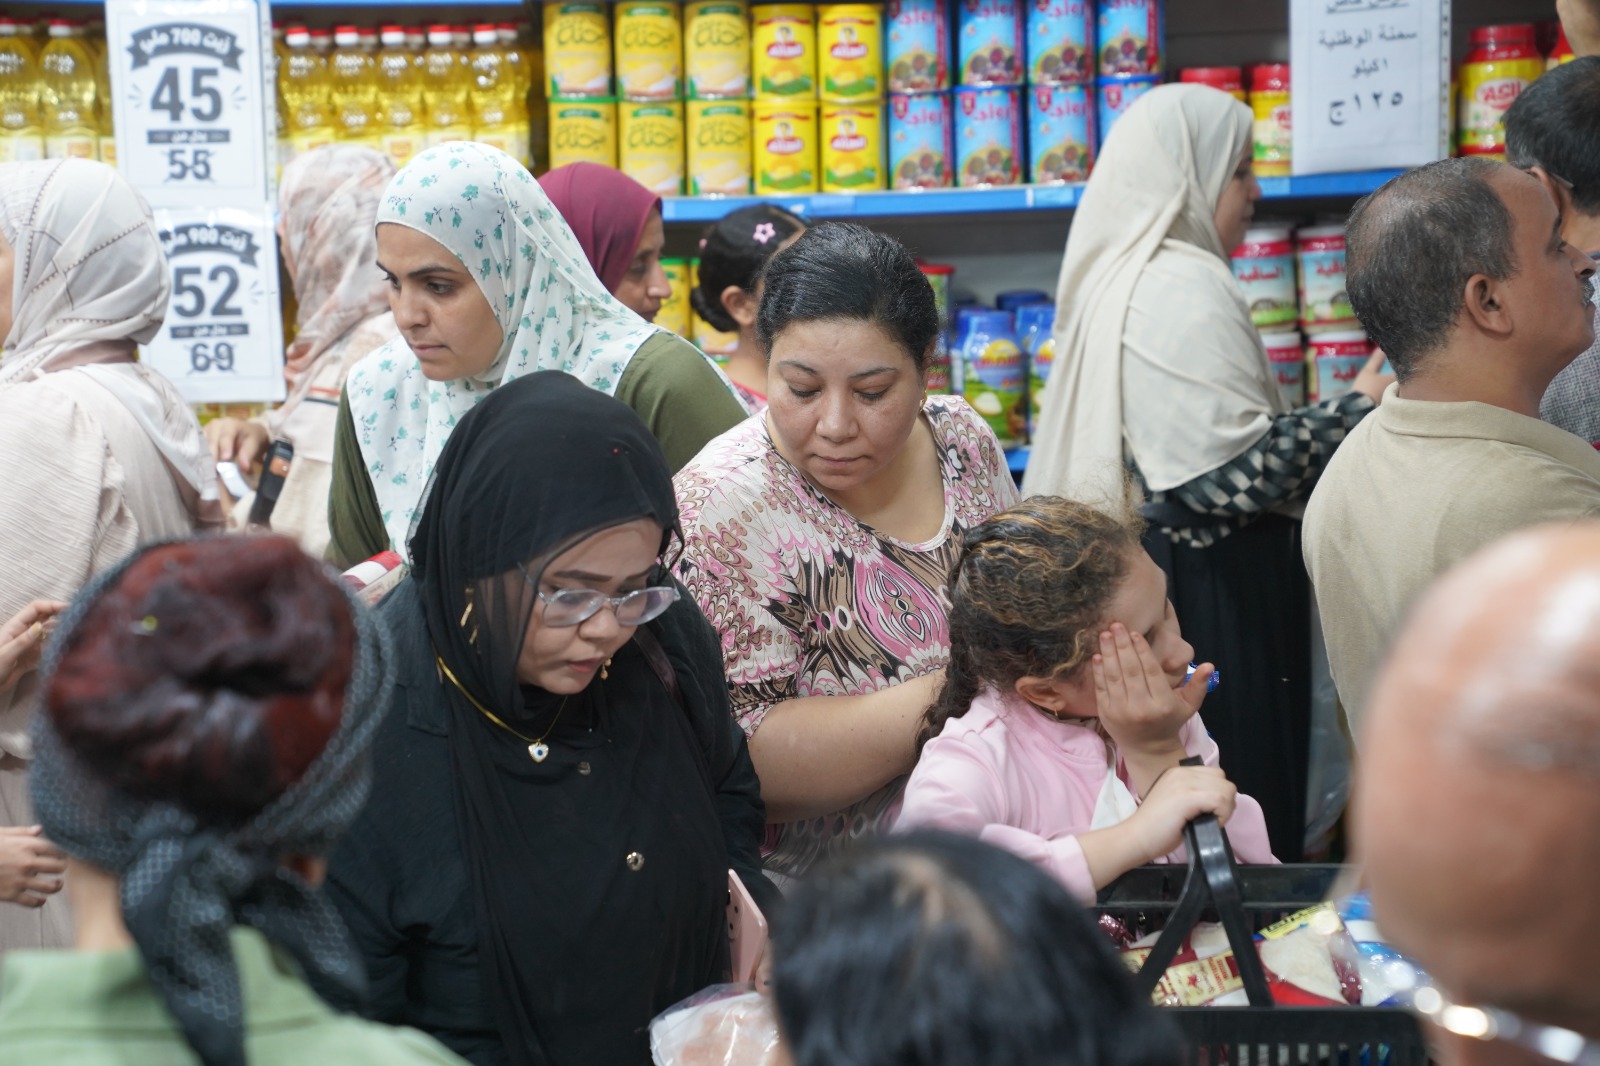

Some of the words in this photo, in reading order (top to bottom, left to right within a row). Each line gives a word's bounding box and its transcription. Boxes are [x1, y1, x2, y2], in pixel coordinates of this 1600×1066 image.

[170, 27, 201, 46] 700
[1319, 27, 1372, 51] الوطنية
[1379, 25, 1417, 42] سمنة
[151, 67, 222, 122] 45
[169, 150, 211, 180] 55
[188, 227, 219, 246] 900
[173, 265, 243, 319] 52
[190, 342, 235, 373] 69
